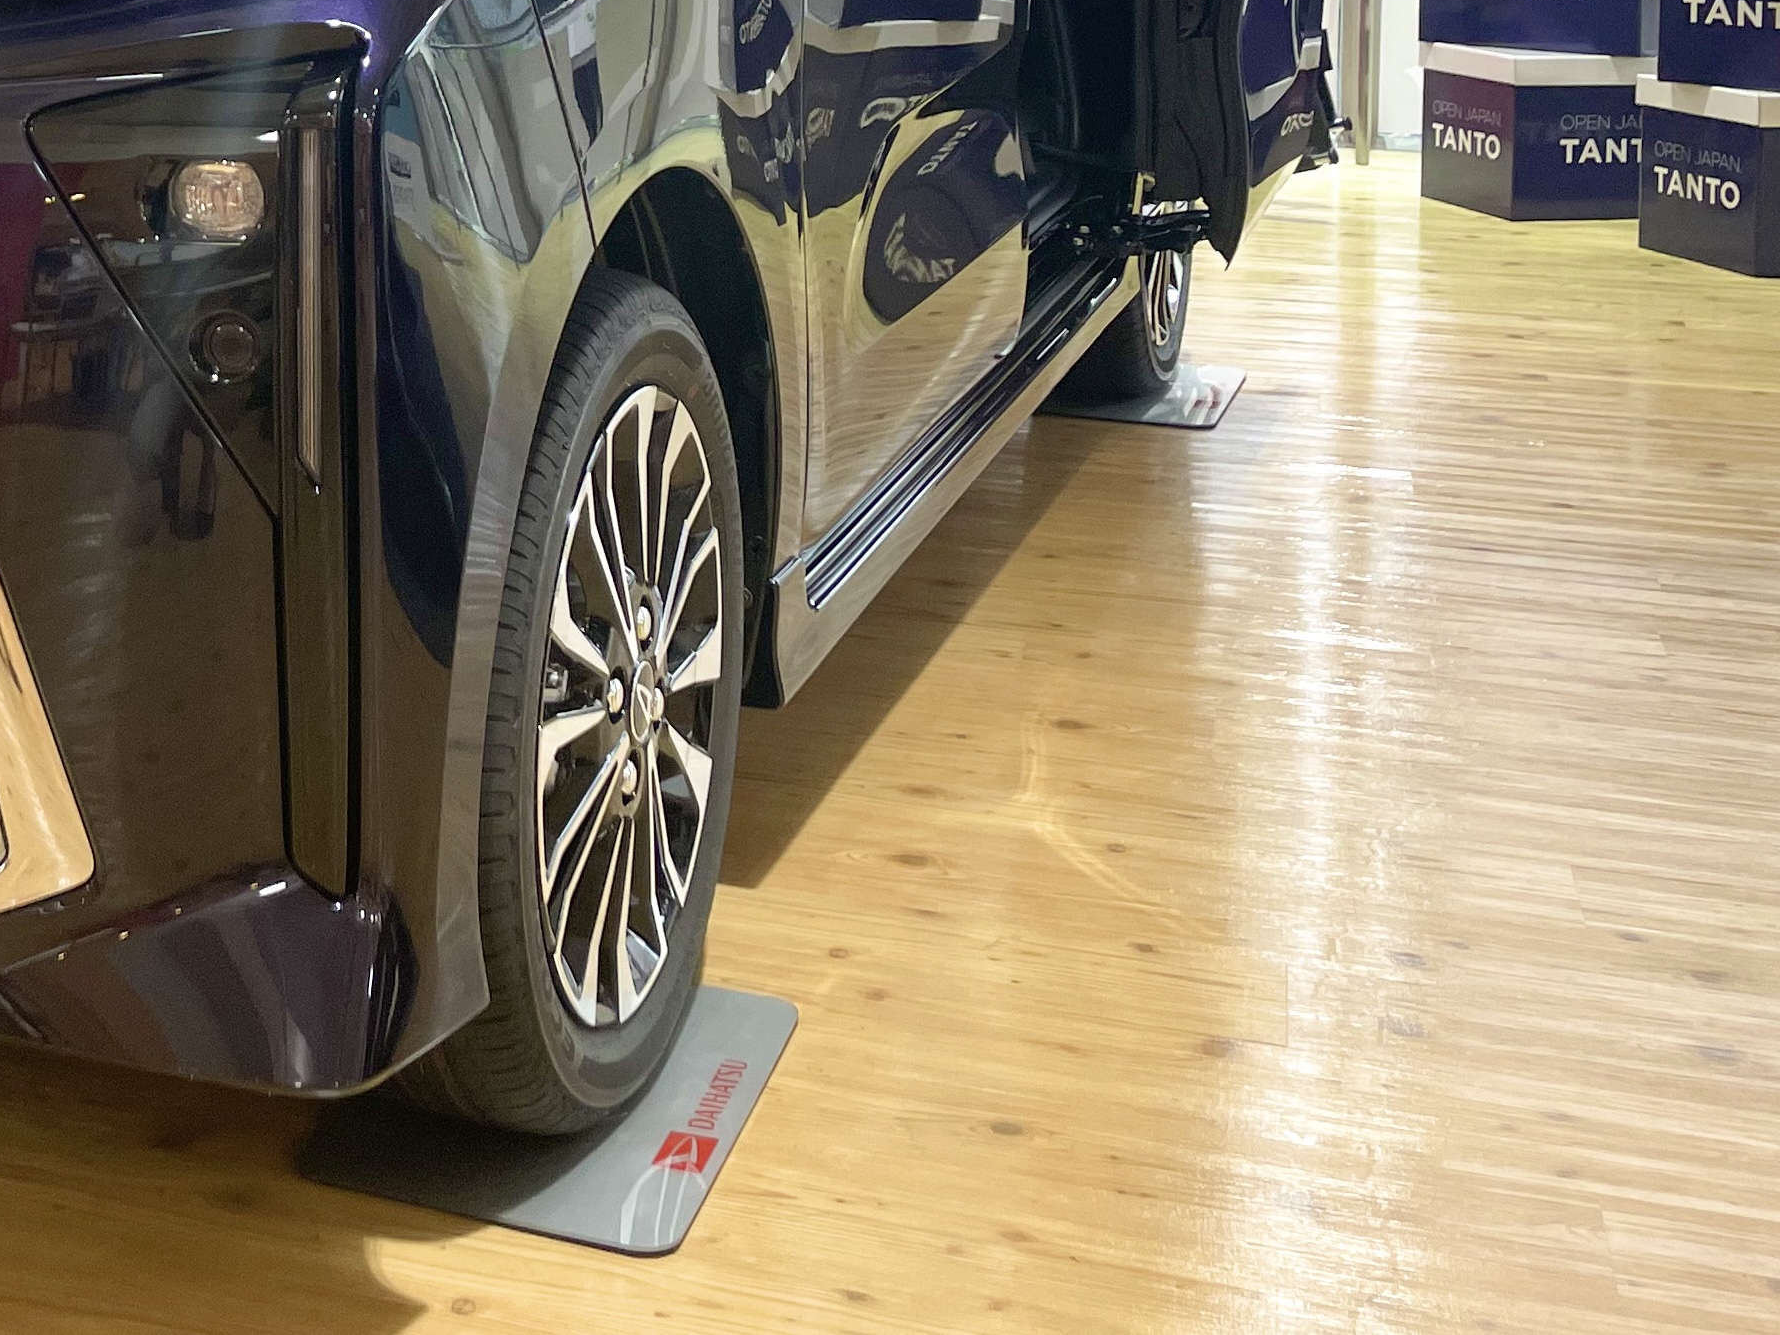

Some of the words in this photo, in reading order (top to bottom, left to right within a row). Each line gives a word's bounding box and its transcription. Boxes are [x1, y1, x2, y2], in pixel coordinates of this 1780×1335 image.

[1432, 99, 1461, 117] OPEN
[1561, 113, 1610, 131] OPEN
[1432, 122, 1502, 160] TANTO
[1559, 137, 1643, 164] TANT
[1654, 140, 1691, 163] OPEN
[1654, 165, 1741, 210] TANTO
[687, 1058, 748, 1130] DAIHATSU
